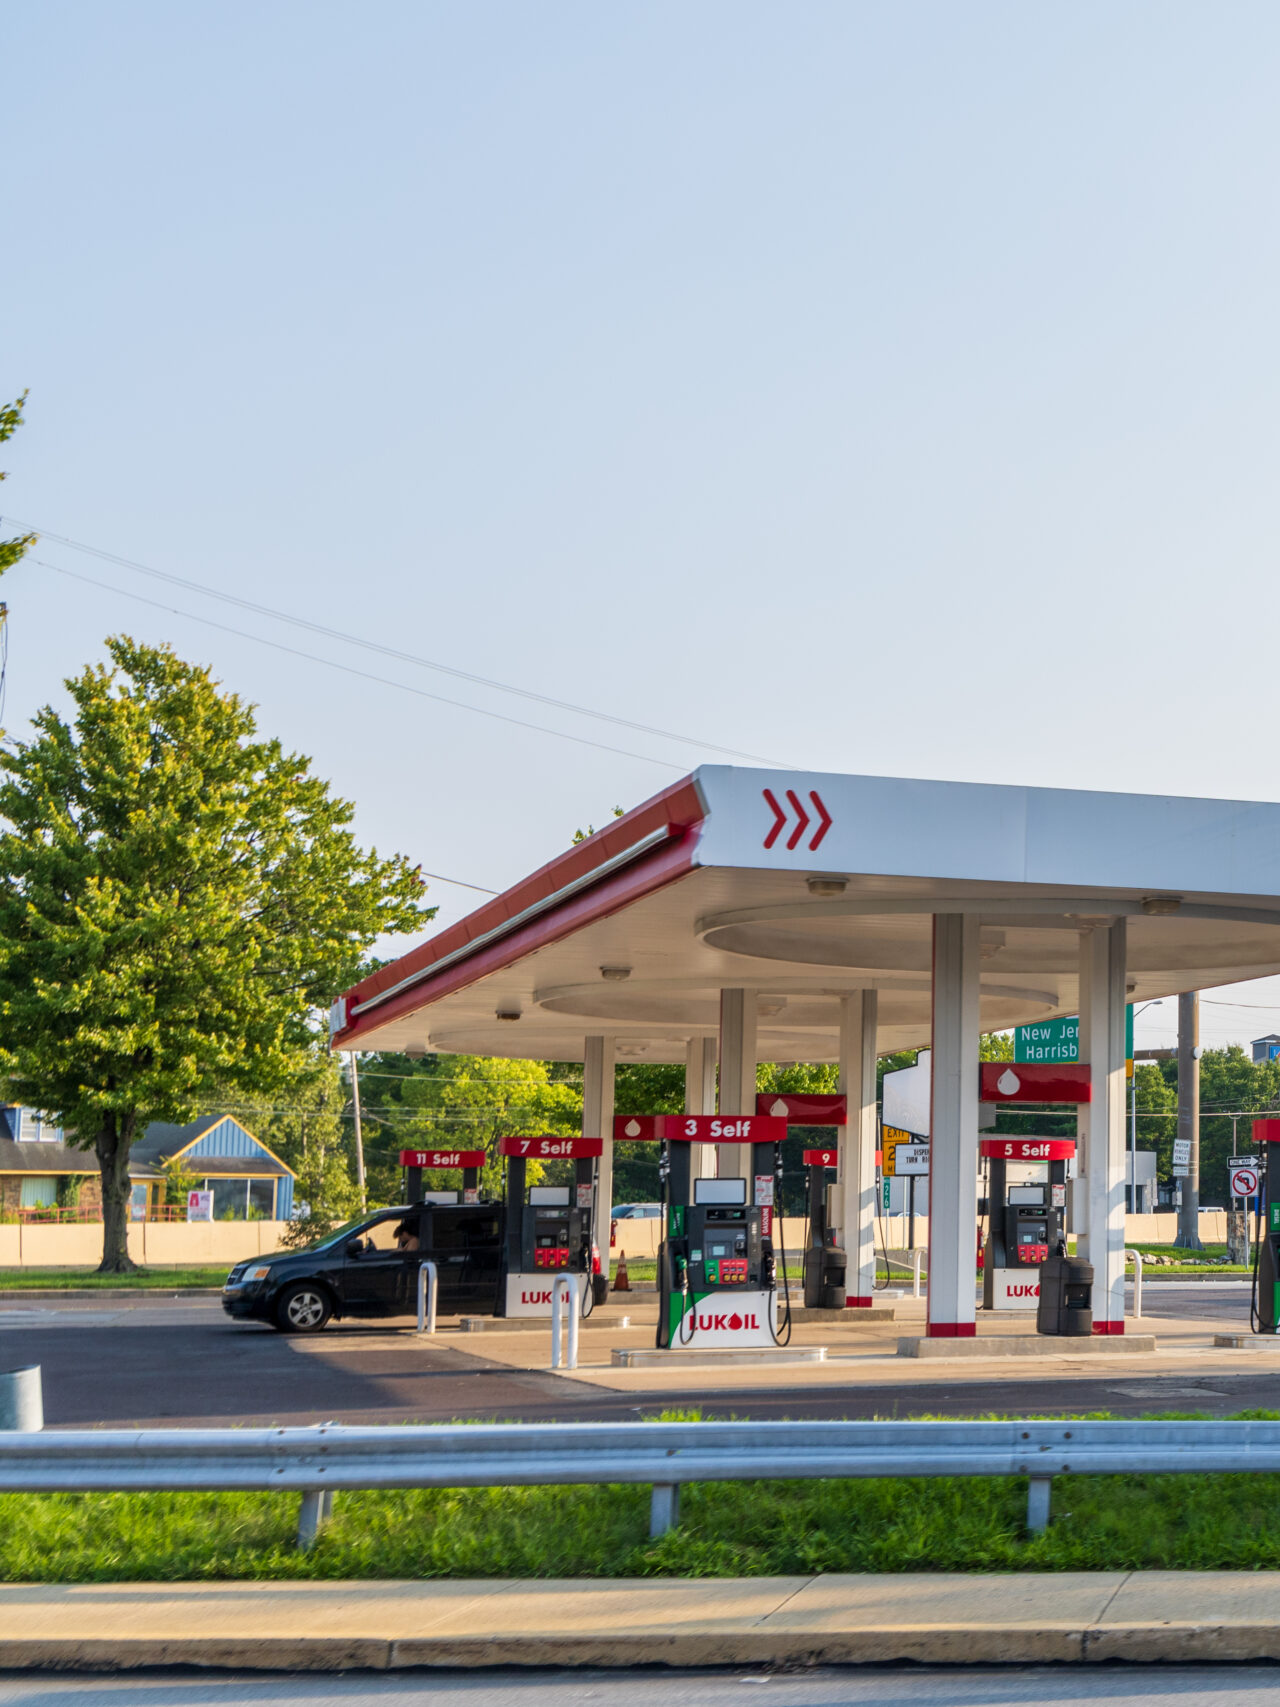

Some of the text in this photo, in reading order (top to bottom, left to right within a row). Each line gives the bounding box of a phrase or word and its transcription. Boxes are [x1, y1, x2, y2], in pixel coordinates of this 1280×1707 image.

[1021, 1027, 1051, 1041] New
[1026, 1043, 1077, 1059] Harrisb
[684, 1119, 751, 1137] 3 Self
[520, 1141, 573, 1154] 7 Self
[1004, 1143, 1050, 1156] 5 Self
[416, 1153, 460, 1165] 11 Self
[822, 1153, 831, 1164] 9
[689, 1312, 760, 1331] LUKOIL
